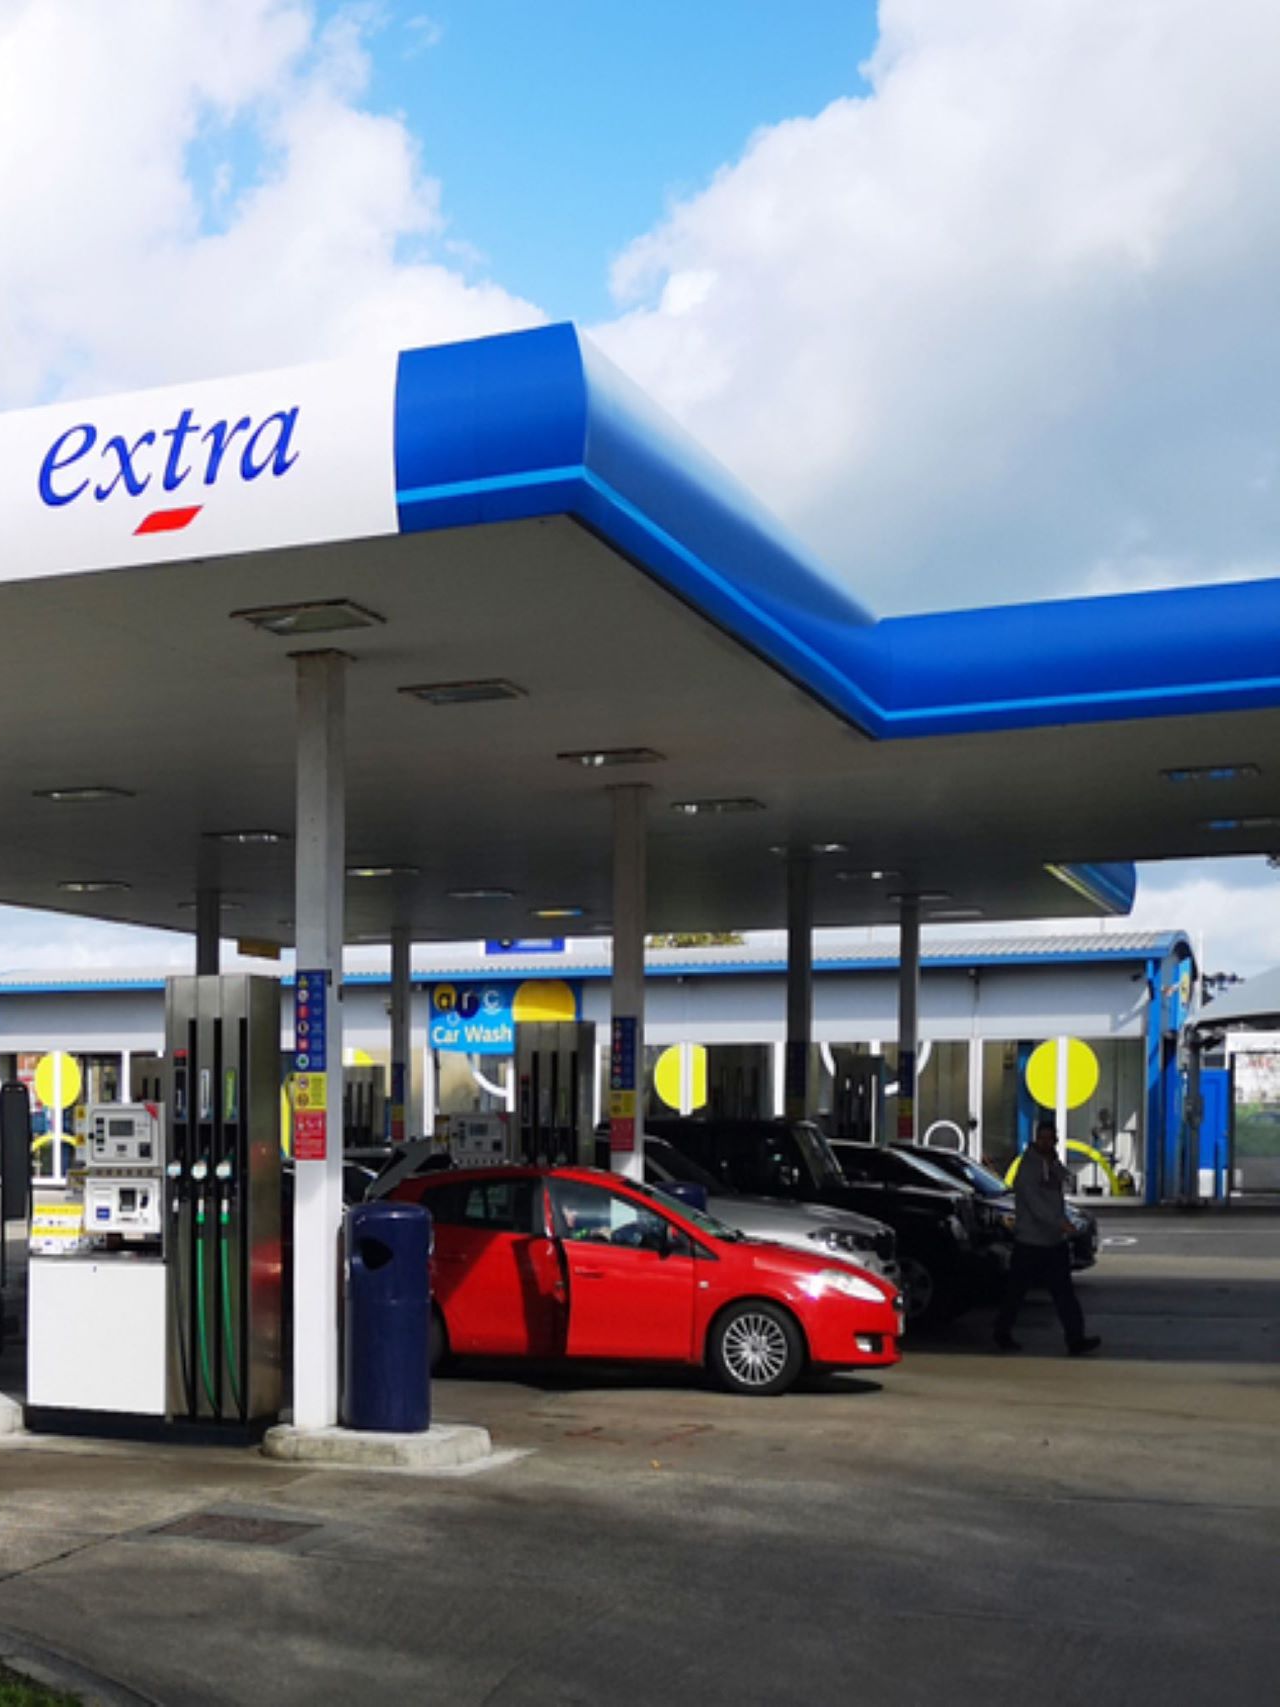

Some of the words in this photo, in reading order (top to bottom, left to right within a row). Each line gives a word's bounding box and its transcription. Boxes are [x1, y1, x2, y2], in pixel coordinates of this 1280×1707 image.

[38, 406, 300, 507] extra
[432, 1026, 459, 1044] Car
[464, 1022, 512, 1043] Wash
